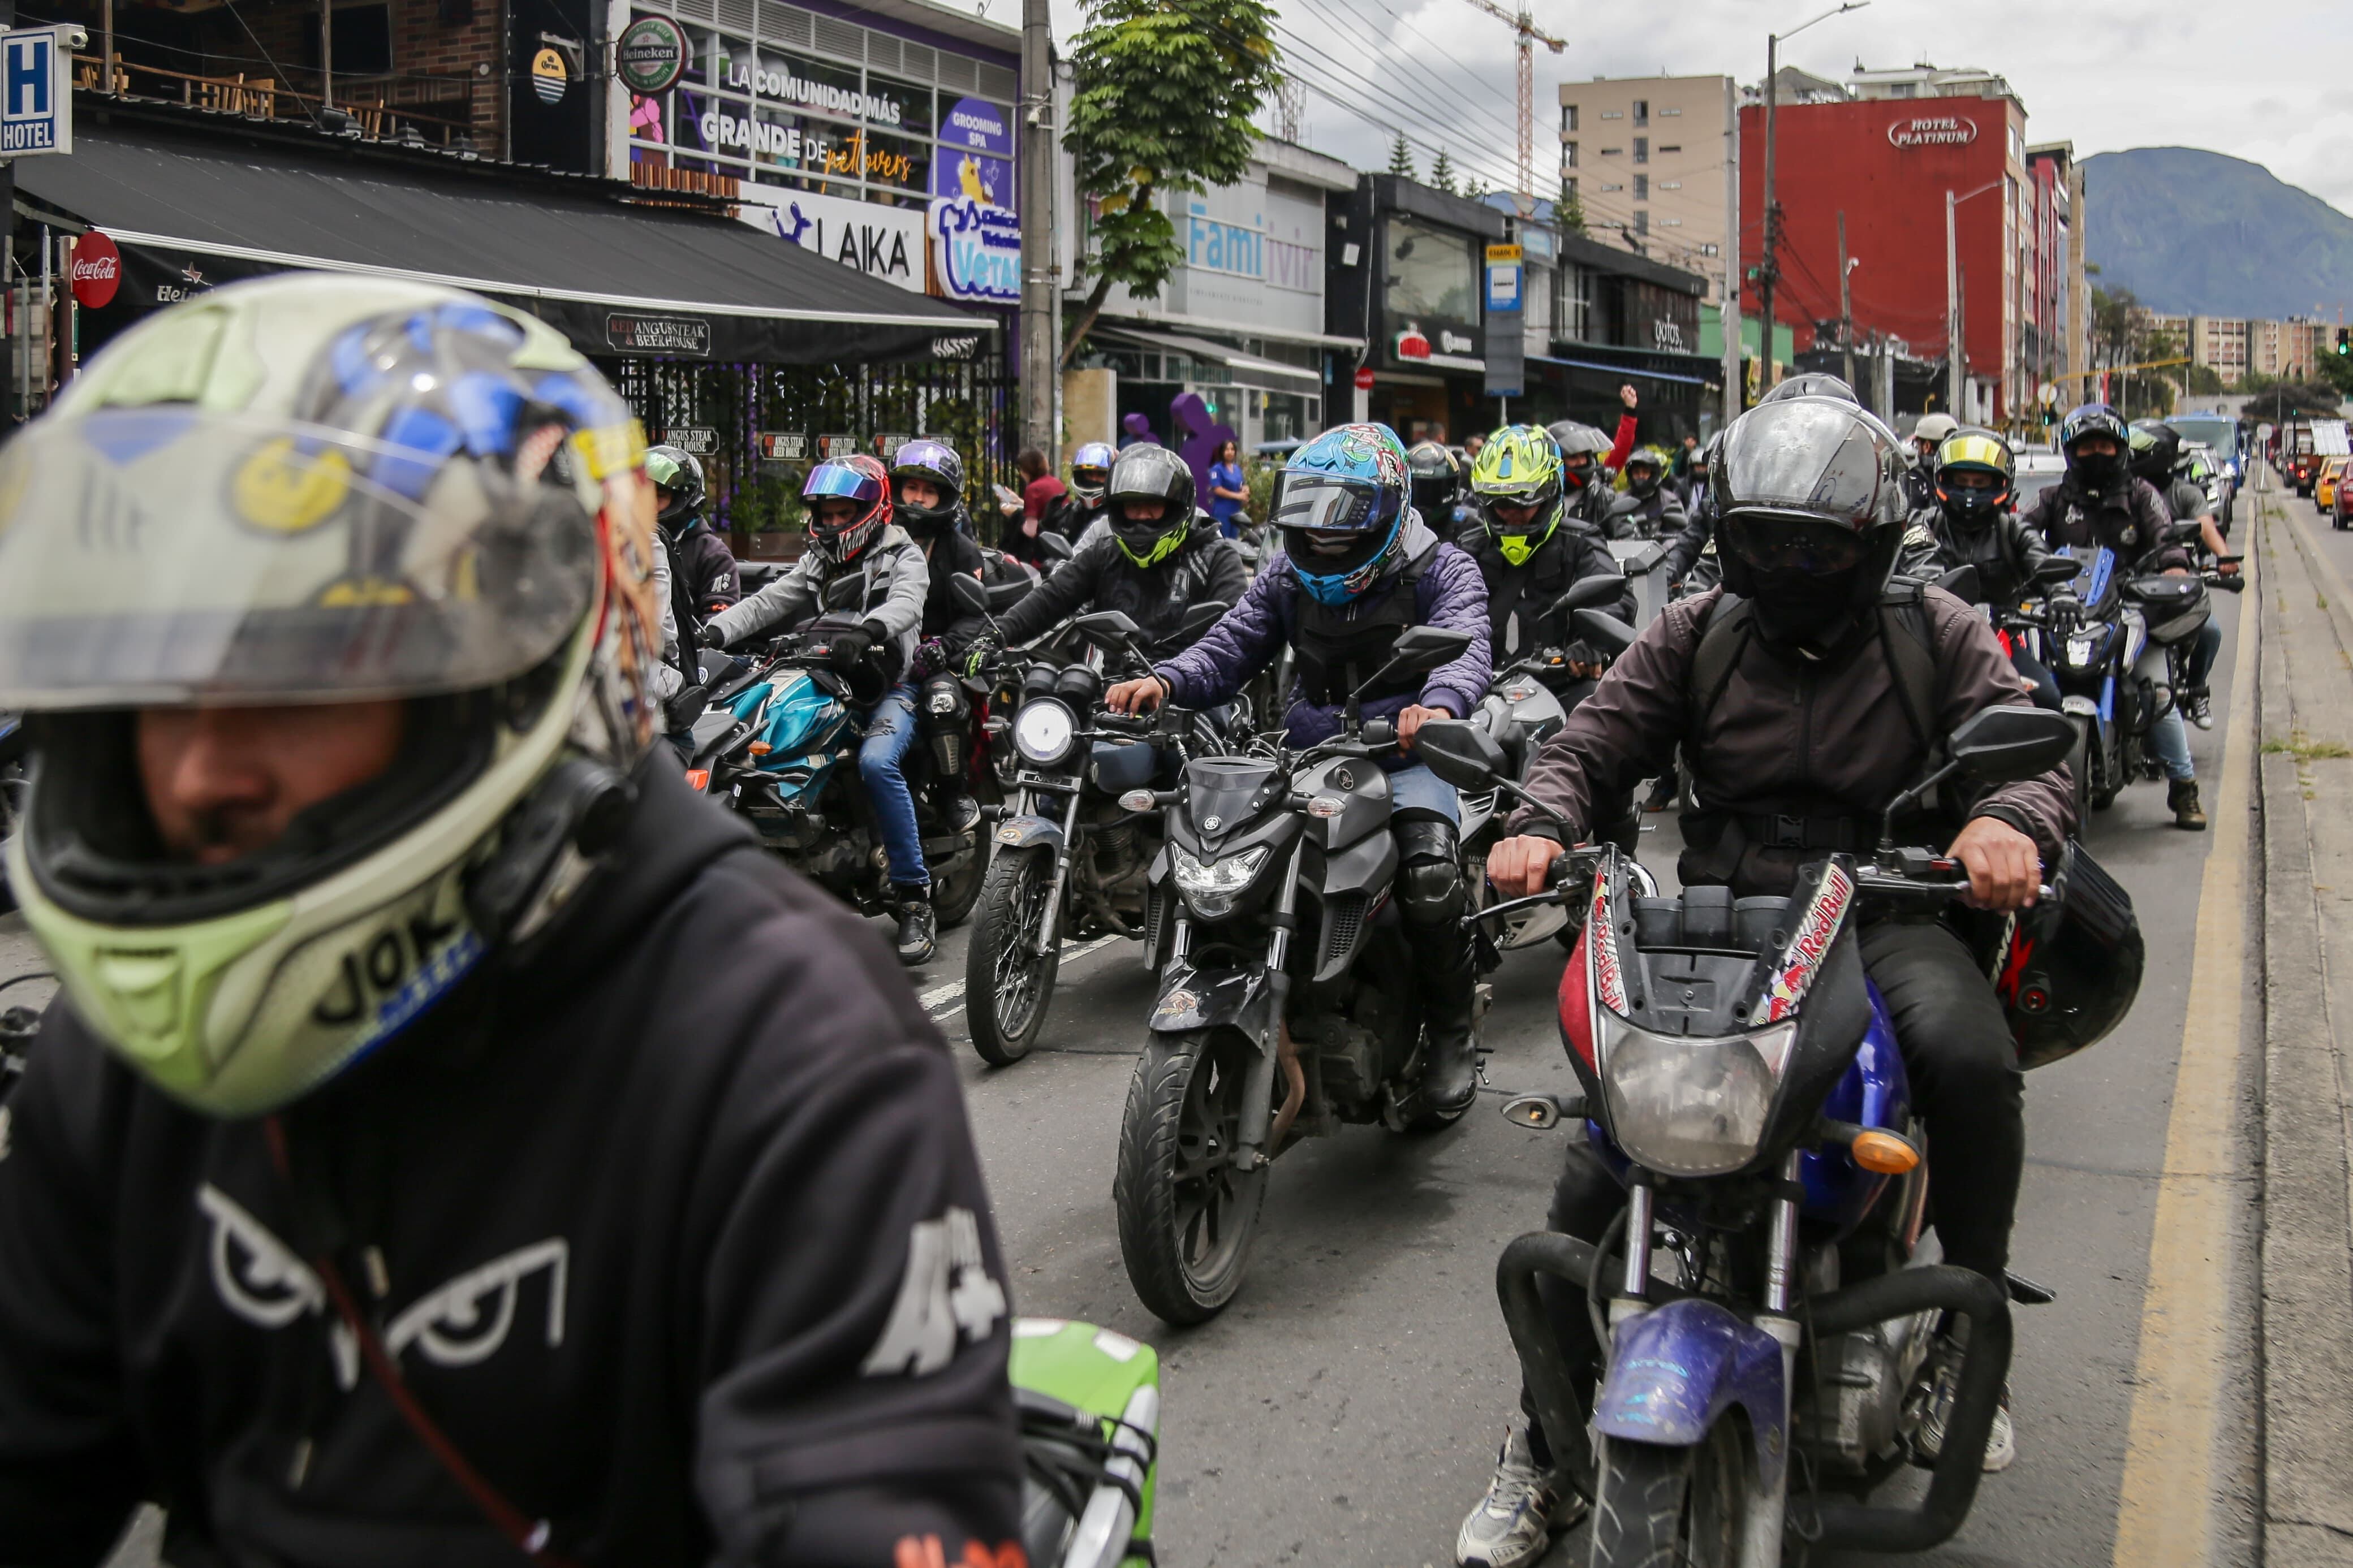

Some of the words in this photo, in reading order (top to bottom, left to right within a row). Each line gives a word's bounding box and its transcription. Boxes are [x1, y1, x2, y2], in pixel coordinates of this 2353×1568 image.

[623, 47, 674, 60] Heineken
[8, 41, 48, 114] H
[729, 62, 751, 89] LA
[756, 70, 863, 115] COMUNIDAD
[865, 92, 900, 124] MÁS
[953, 112, 1003, 136] GROOMING
[1911, 116, 1959, 132] HOTEL
[3, 122, 53, 149] HOTEL
[701, 112, 801, 158] GRANDE
[807, 139, 828, 163] DE
[969, 132, 987, 149] SPA
[1897, 130, 1970, 145] PLATINUM
[611, 319, 634, 332] RED
[625, 334, 634, 346] &
[667, 430, 689, 441] ANGUS
[690, 430, 712, 442] STEAK
[684, 441, 706, 452] HOUSE
